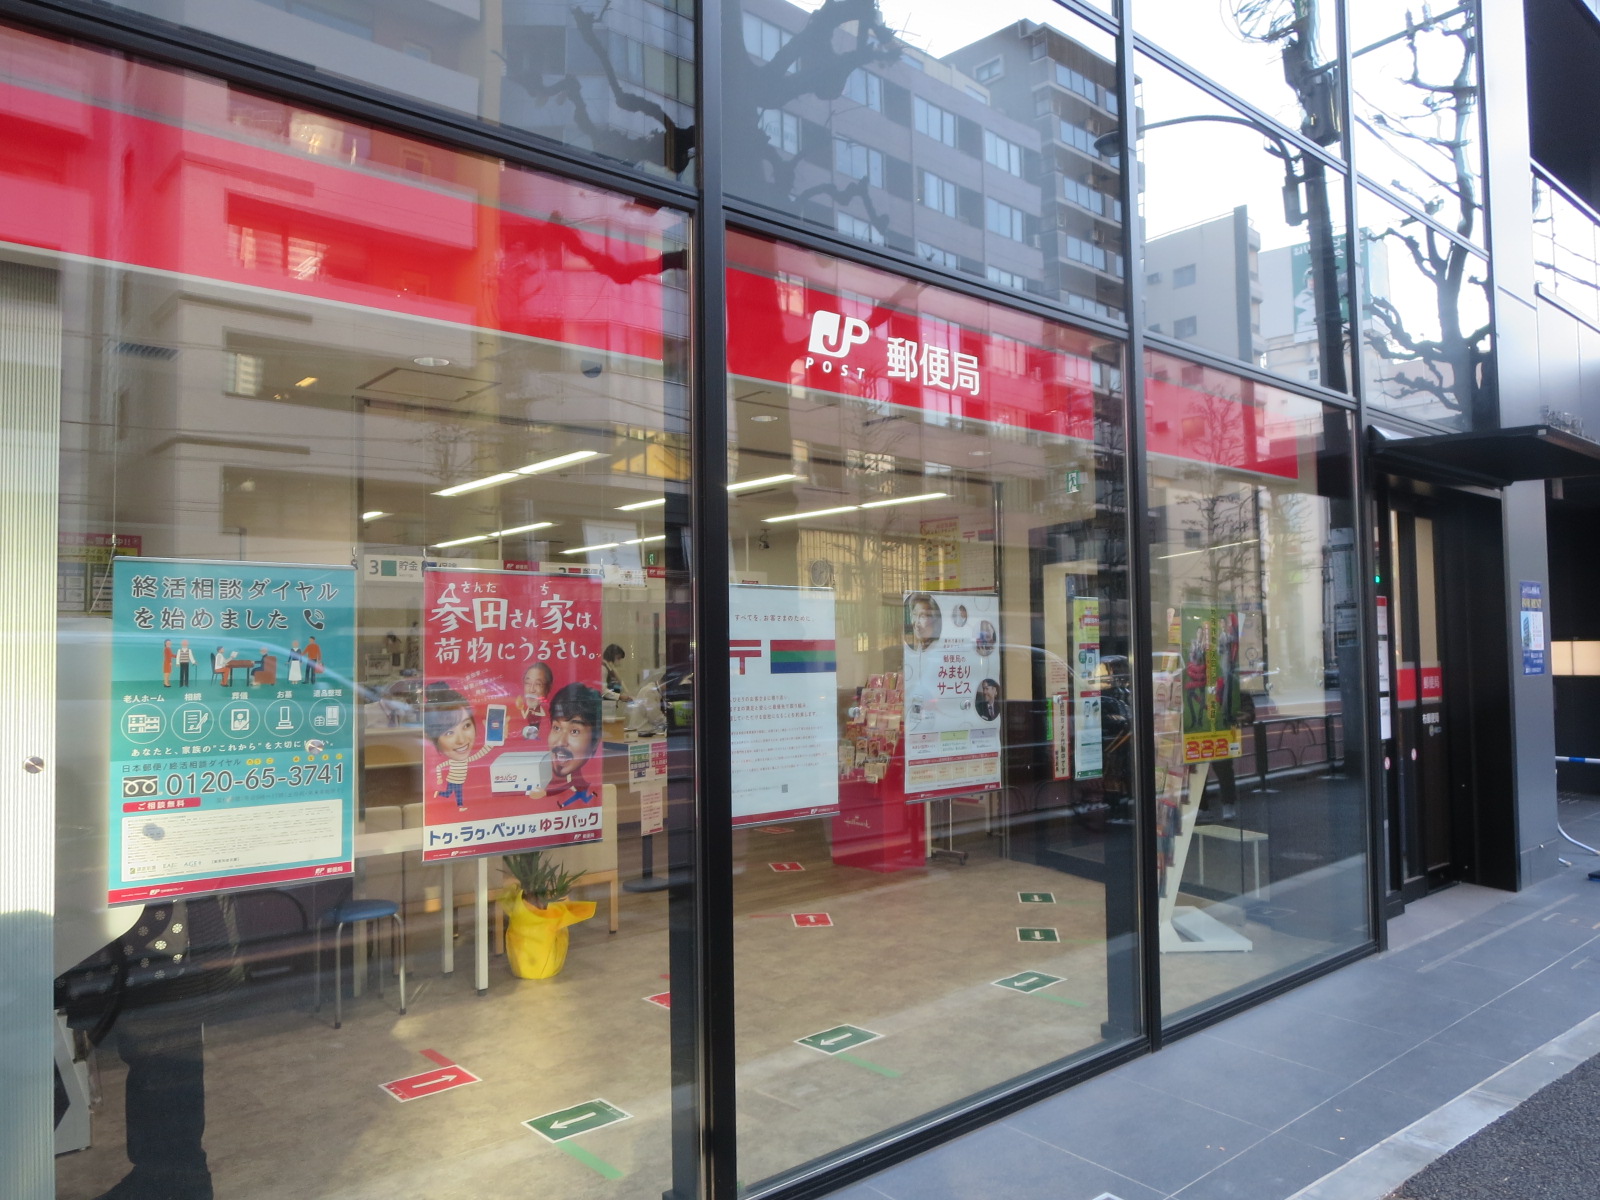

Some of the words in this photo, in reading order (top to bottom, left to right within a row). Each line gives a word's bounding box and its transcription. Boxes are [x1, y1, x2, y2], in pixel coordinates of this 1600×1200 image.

[804, 356, 866, 380] POST
[887, 336, 980, 396] 郵便局
[369, 559, 379, 575] 3
[398, 560, 418, 571] 貯金
[131, 574, 339, 602] 終活相談ダイヤル
[461, 580, 497, 594] さんた
[540, 583, 549, 596] ち
[428, 583, 599, 634] 参田さん家は、
[133, 606, 289, 630] を始めました
[434, 636, 596, 664] 荷物にうるさい。
[937, 665, 972, 680] みまもり
[937, 681, 972, 695] サービス
[1423, 675, 1440, 689] 郵便局
[123, 694, 165, 704] 老人ホーム
[184, 692, 202, 701] 相続
[165, 762, 343, 796] 0120-65-3741
[137, 800, 185, 811] ご相談無料
